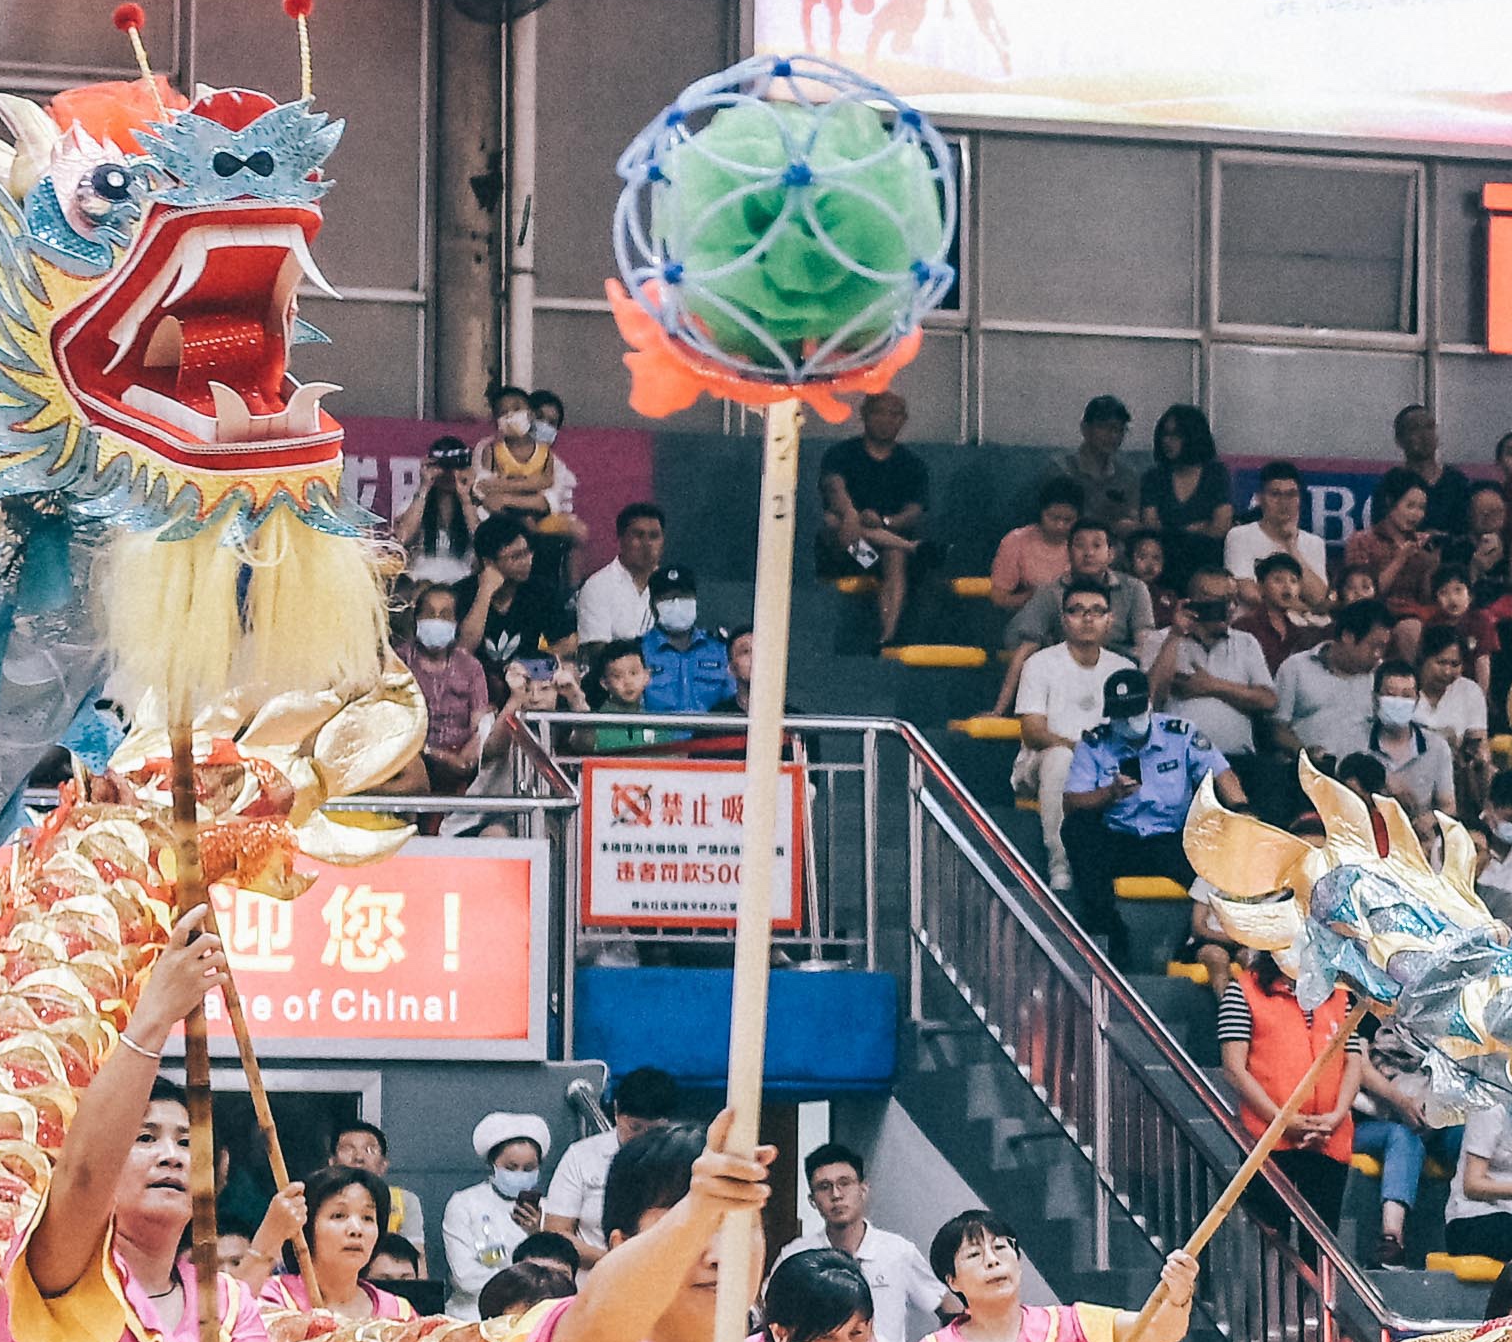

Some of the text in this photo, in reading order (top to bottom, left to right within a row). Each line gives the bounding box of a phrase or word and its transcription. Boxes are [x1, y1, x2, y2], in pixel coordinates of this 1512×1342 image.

[660, 791, 744, 828] 禁止吸
[284, 989, 321, 1021] of
[331, 988, 458, 1022] China!
